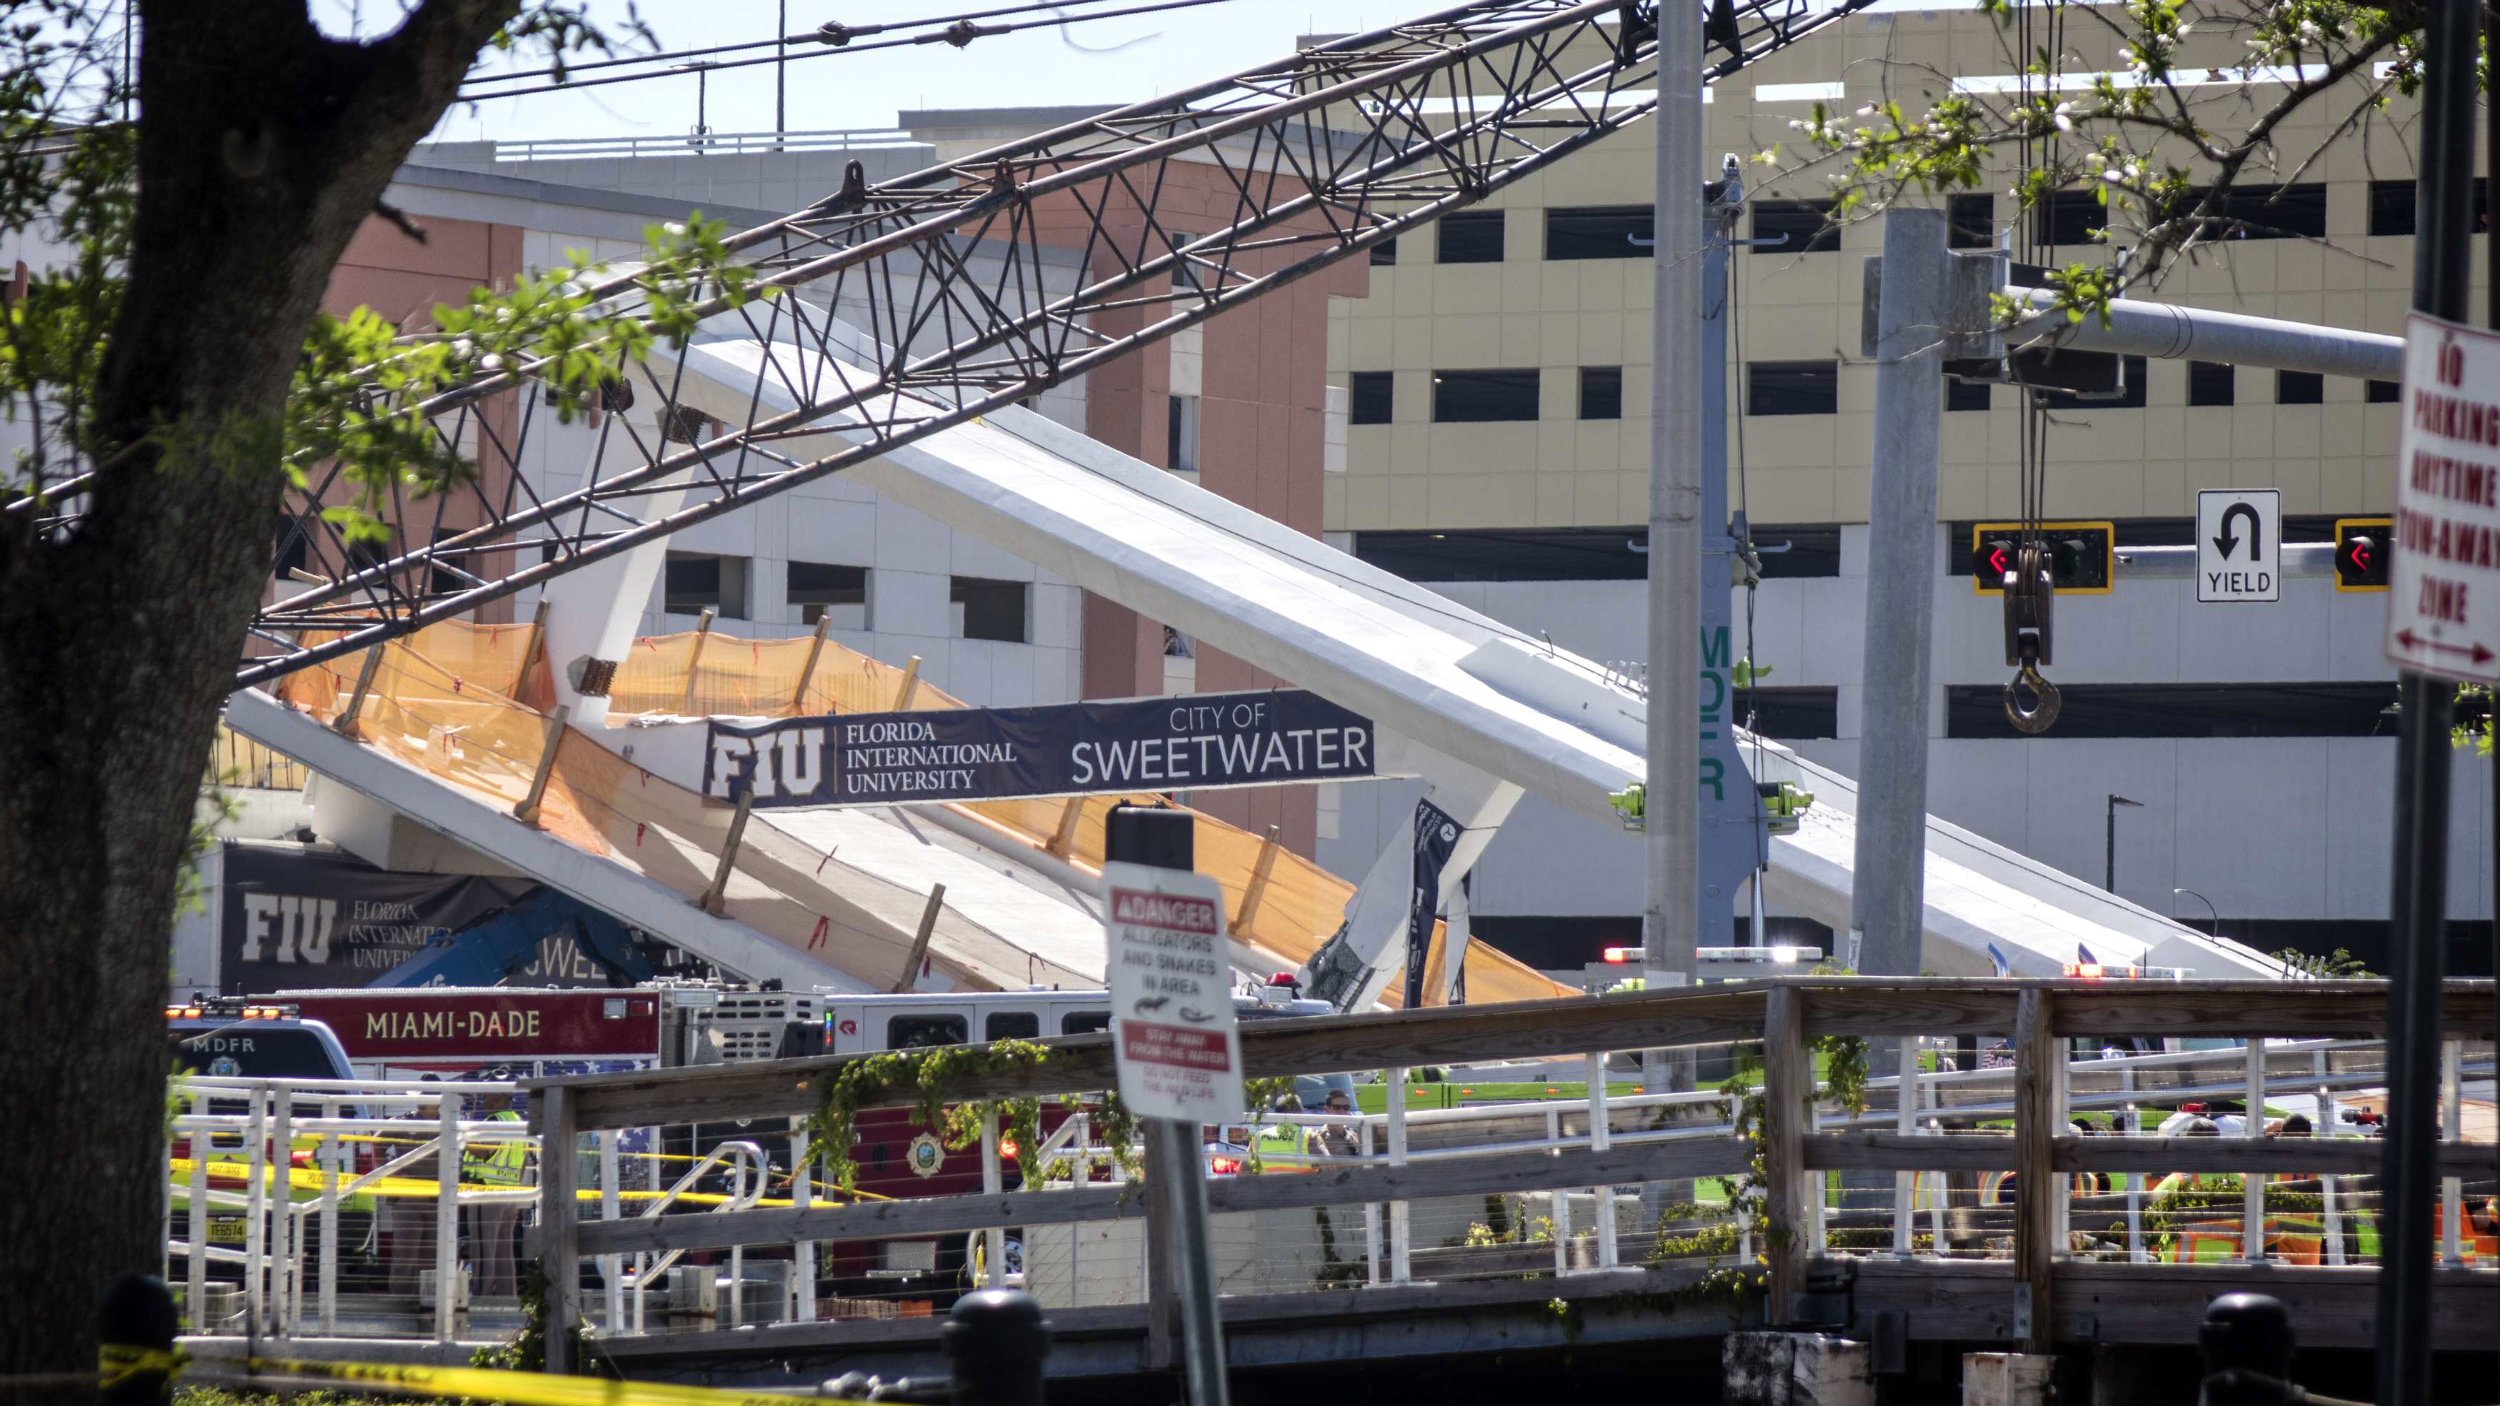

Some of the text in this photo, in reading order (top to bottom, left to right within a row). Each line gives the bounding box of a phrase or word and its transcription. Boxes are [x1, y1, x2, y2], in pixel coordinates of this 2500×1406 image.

[2436, 340, 2464, 388] NO
[2413, 387, 2500, 447] PARKING
[2410, 449, 2497, 508] ANYTIME
[2207, 572, 2271, 593] YIELD
[2418, 573, 2467, 624] ZONE
[1169, 702, 1266, 732] CITY OF
[846, 721, 937, 745] FLORIDA
[711, 726, 824, 799] FIU
[846, 742, 1017, 768] INTERNATIONAL
[1071, 726, 1368, 785] SWEETWATER
[846, 769, 976, 794] UNIVERSITY
[353, 900, 419, 920] FLORIDA
[1131, 895, 1213, 931] DANGER
[242, 892, 338, 965] FIU
[1123, 948, 1217, 976] AND SNAKES
[1143, 975, 1201, 996] IN AREA
[366, 1010, 540, 1039] MIAMI-DADE
[193, 1038, 255, 1052] MDFR
[1261, 1133, 1294, 1141] POLICE
